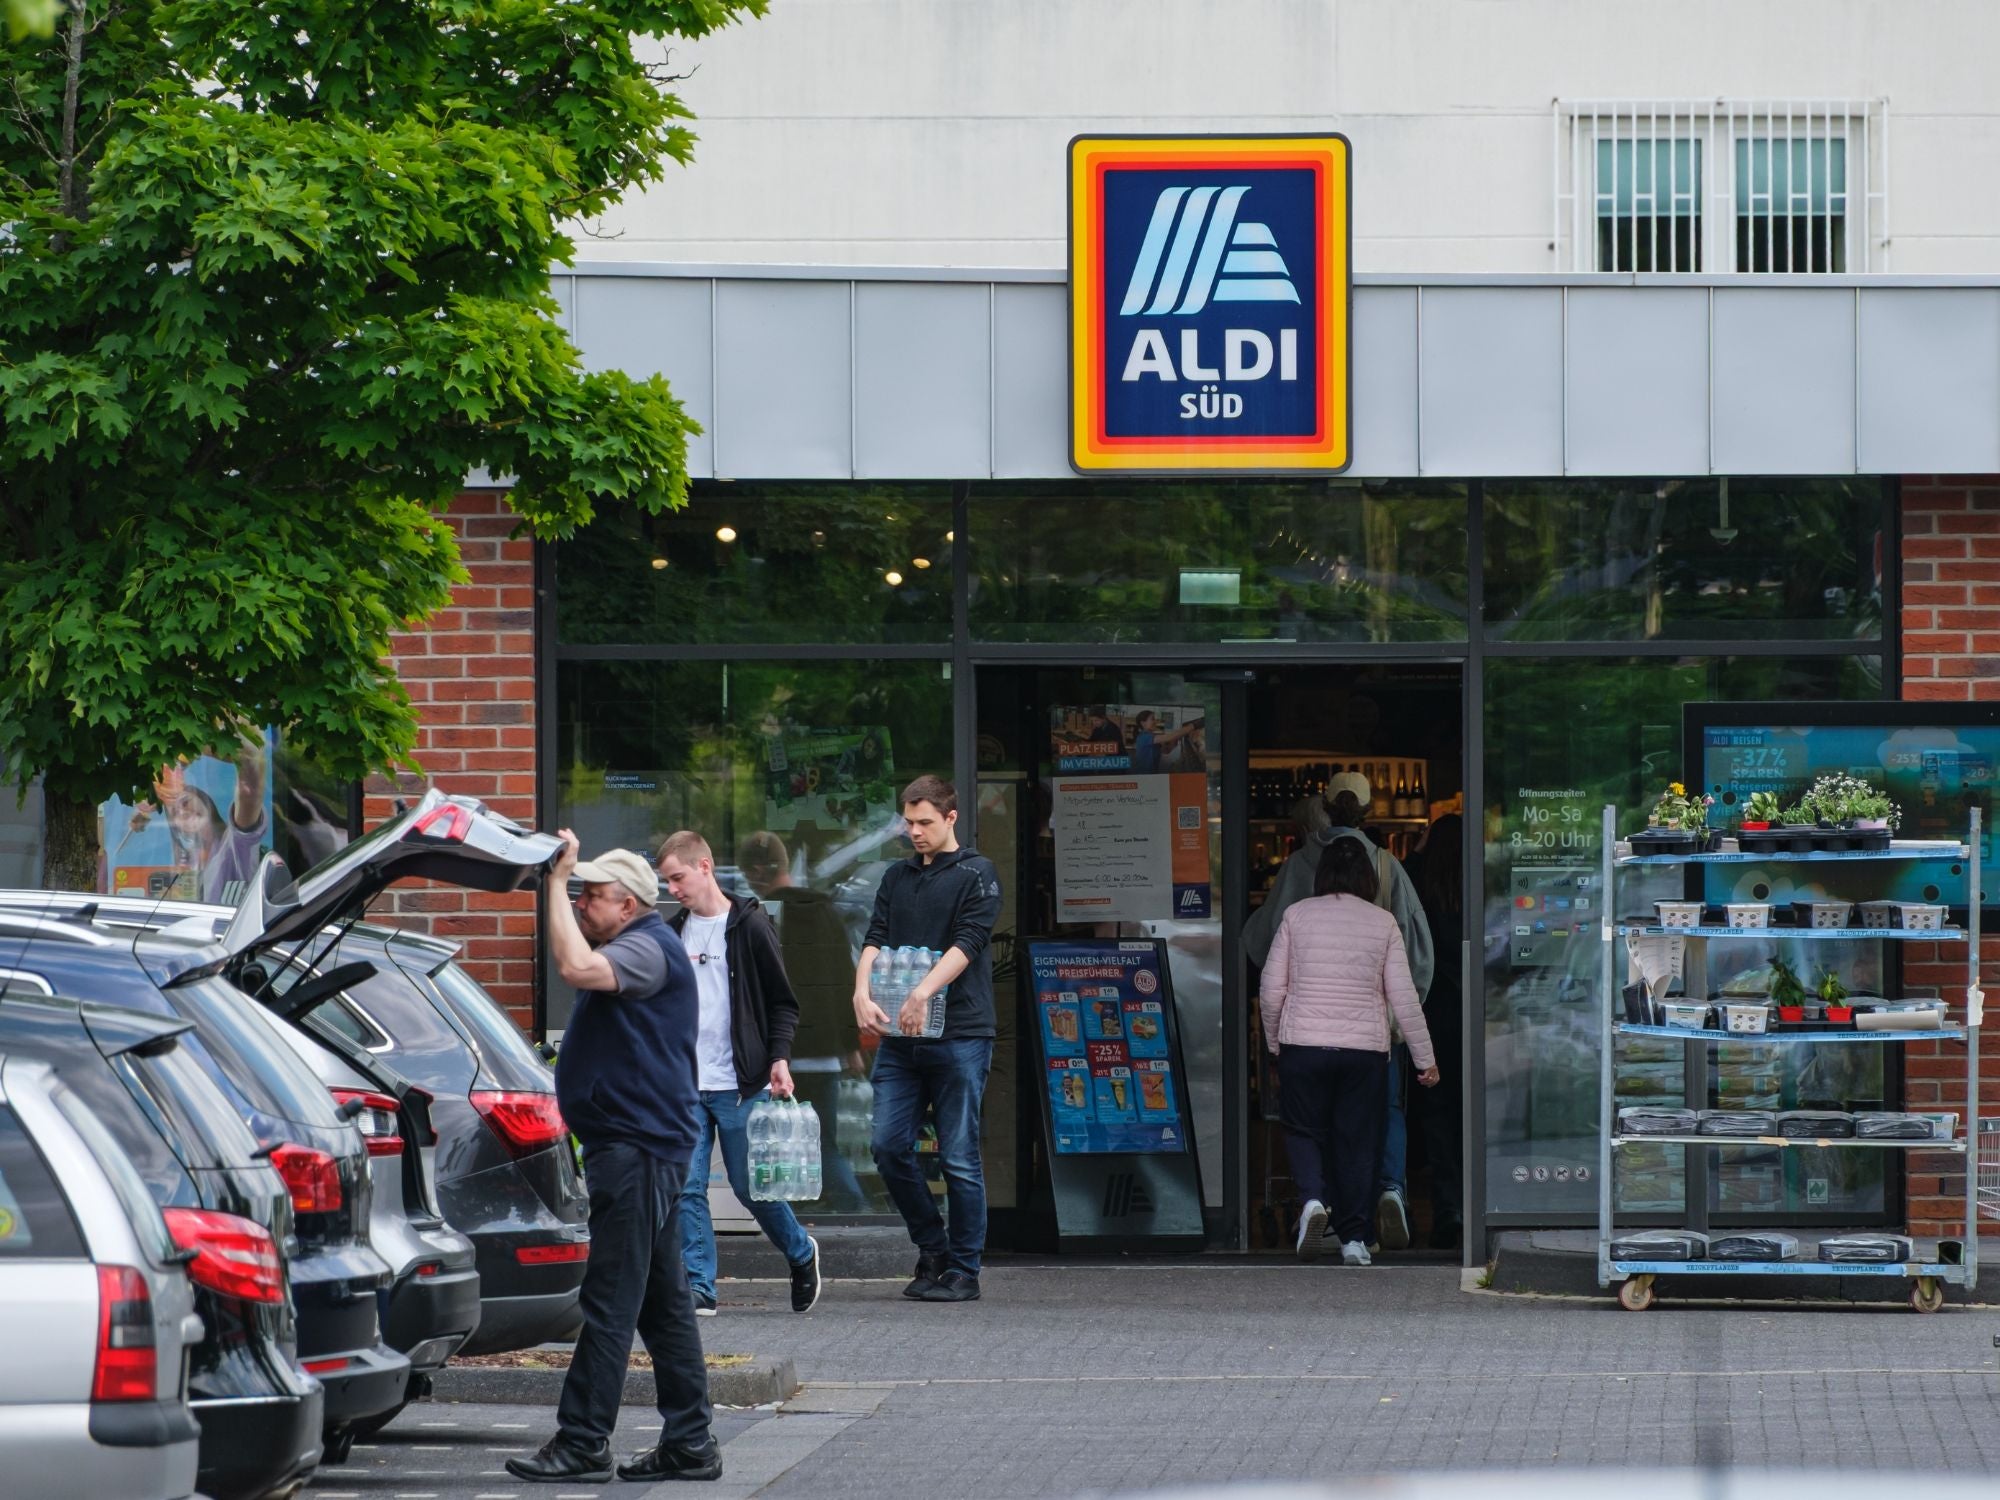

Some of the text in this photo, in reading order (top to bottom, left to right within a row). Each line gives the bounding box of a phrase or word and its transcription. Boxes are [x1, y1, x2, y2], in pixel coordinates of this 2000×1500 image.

[1121, 329, 1297, 381] ALDI
[1180, 384, 1243, 419] SÜD
[1712, 736, 1728, 745] ALDI
[1059, 743, 1117, 754] PLATZ FREI
[1060, 757, 1131, 769] IM VERKAUF!
[1518, 787, 1586, 799] Öffnungszeiten
[1523, 805, 1582, 822] Mo–Sa
[1511, 830, 1594, 848] 8–20 Uhr
[1034, 956, 1141, 966] EIGENMARKEN-VIELFALT
[1036, 967, 1122, 978] VOM PREISFÜHRER.
